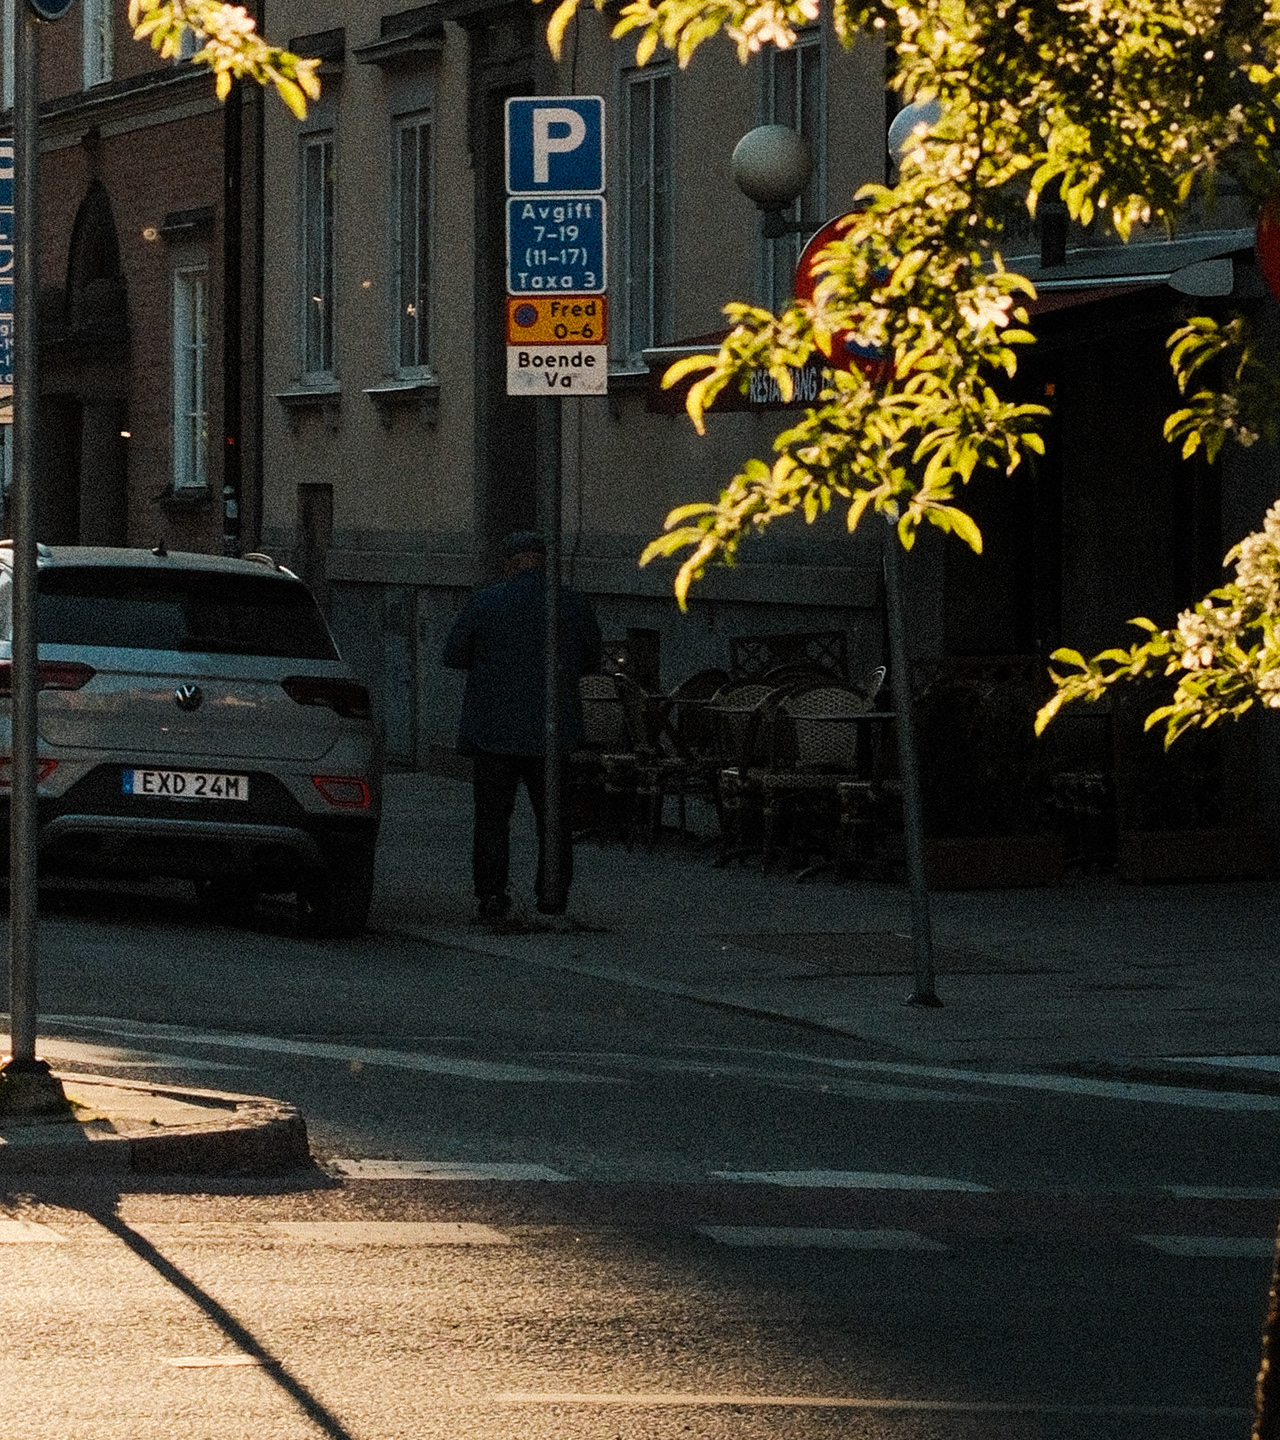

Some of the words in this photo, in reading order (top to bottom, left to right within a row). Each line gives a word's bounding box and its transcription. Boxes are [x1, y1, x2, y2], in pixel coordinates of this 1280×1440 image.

[532, 108, 587, 183] P
[521, 203, 591, 223] Avgift
[533, 225, 579, 242] 7-19
[525, 247, 588, 267] (11-17)
[518, 272, 573, 288] Taxa
[583, 271, 596, 288] 3
[550, 301, 596, 317] Fred
[554, 323, 594, 339] 0-6
[518, 351, 596, 368] Boende
[544, 371, 572, 388] Va
[142, 772, 186, 794] EXD
[194, 775, 239, 797] 24M
